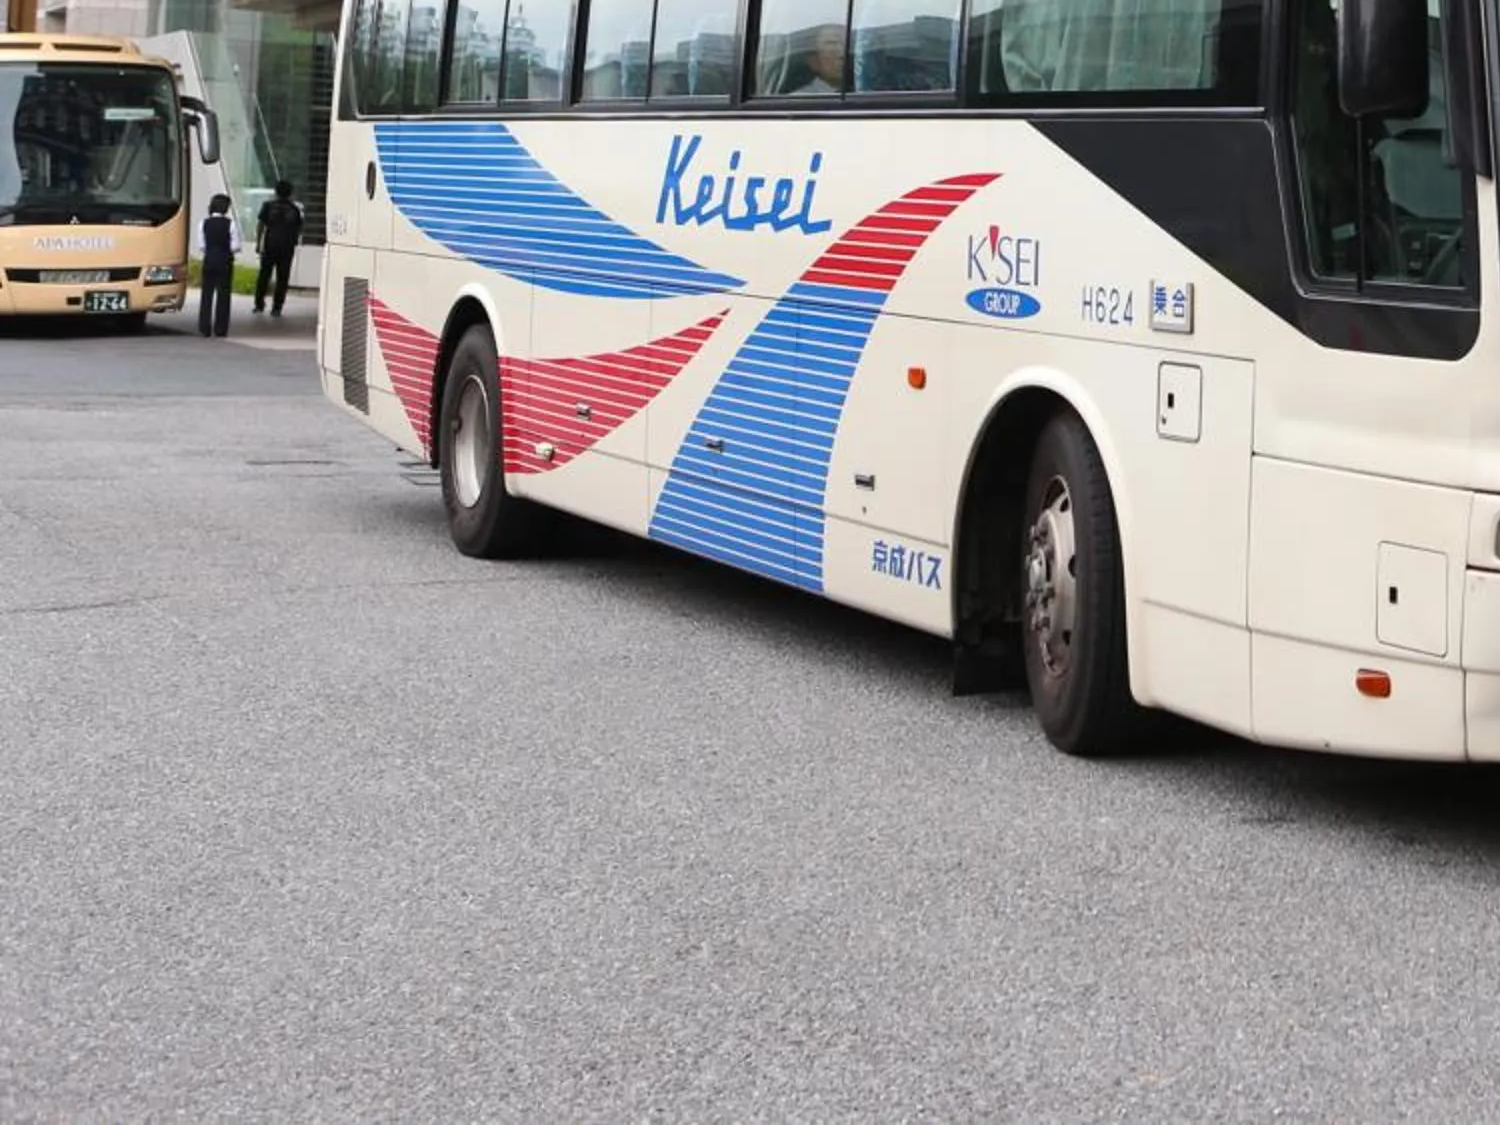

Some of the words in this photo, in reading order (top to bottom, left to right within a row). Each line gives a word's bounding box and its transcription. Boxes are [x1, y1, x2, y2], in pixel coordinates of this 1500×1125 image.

[656, 135, 832, 235] Keisei
[983, 291, 1021, 315] GROUP
[1082, 286, 1133, 325] H624
[872, 540, 943, 590] 京成バス
